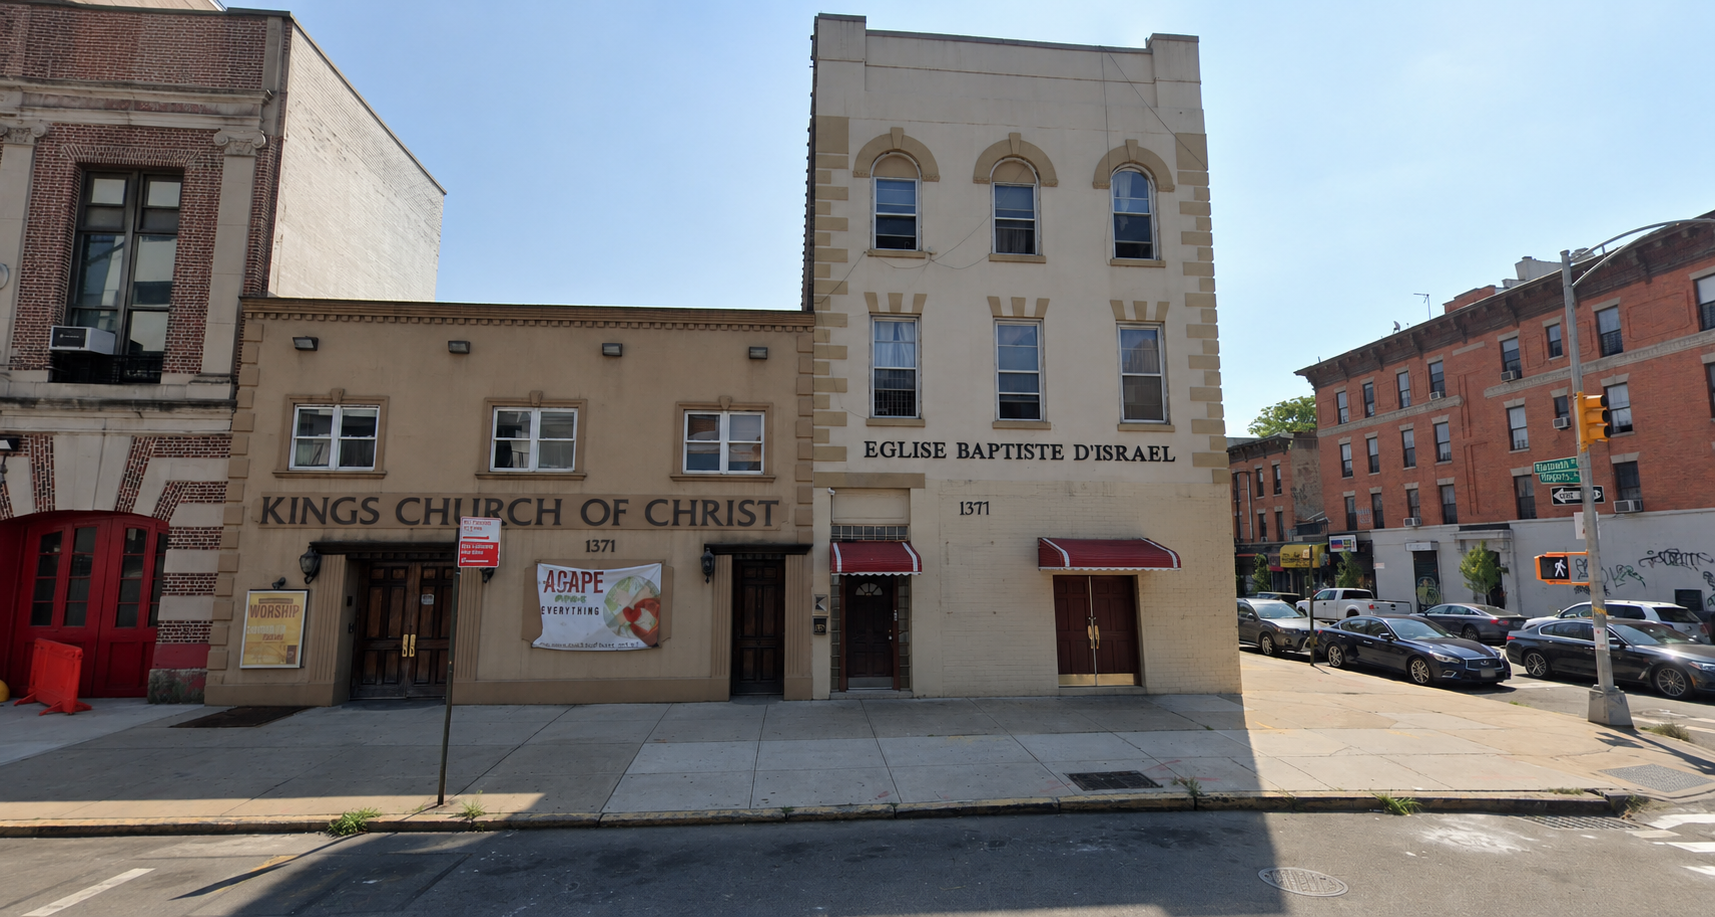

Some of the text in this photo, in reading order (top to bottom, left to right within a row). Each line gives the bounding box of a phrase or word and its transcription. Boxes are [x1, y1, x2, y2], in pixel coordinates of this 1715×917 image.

[863, 440, 1176, 463] EGLISE BAPTISTE D'ISRAEL
[259, 496, 780, 528] KINGS CHURCH OF CHRIST
[960, 500, 990, 516] 1371
[586, 539, 616, 553] 1371
[543, 569, 604, 593] AGAPE
[249, 604, 300, 619] WORSHIP
[541, 605, 600, 616] EVERYTHING
